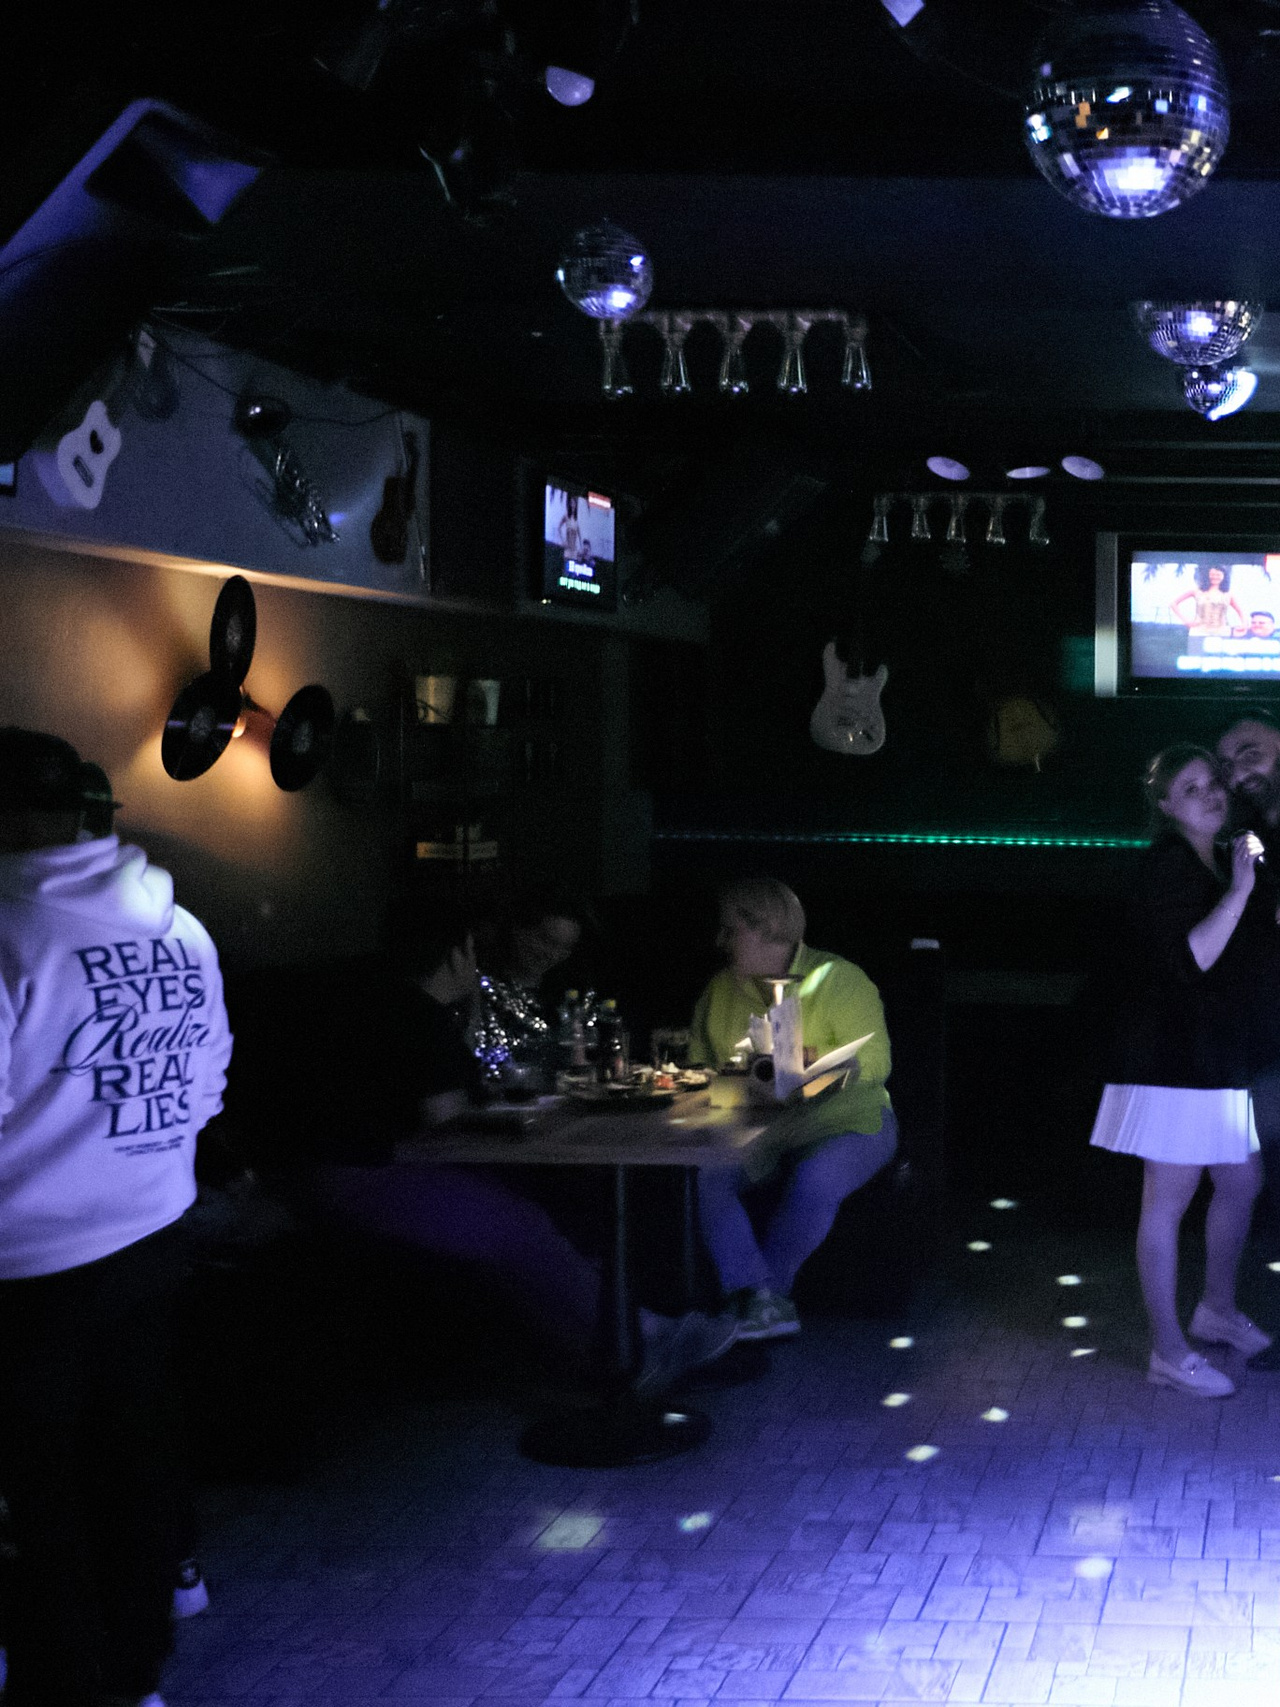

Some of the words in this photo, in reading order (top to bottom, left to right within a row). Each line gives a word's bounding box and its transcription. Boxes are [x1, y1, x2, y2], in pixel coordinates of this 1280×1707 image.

[74, 938, 201, 985] REAL
[91, 974, 206, 1023] EYES
[91, 1052, 194, 1101] REAL
[104, 1090, 190, 1138] LIES
